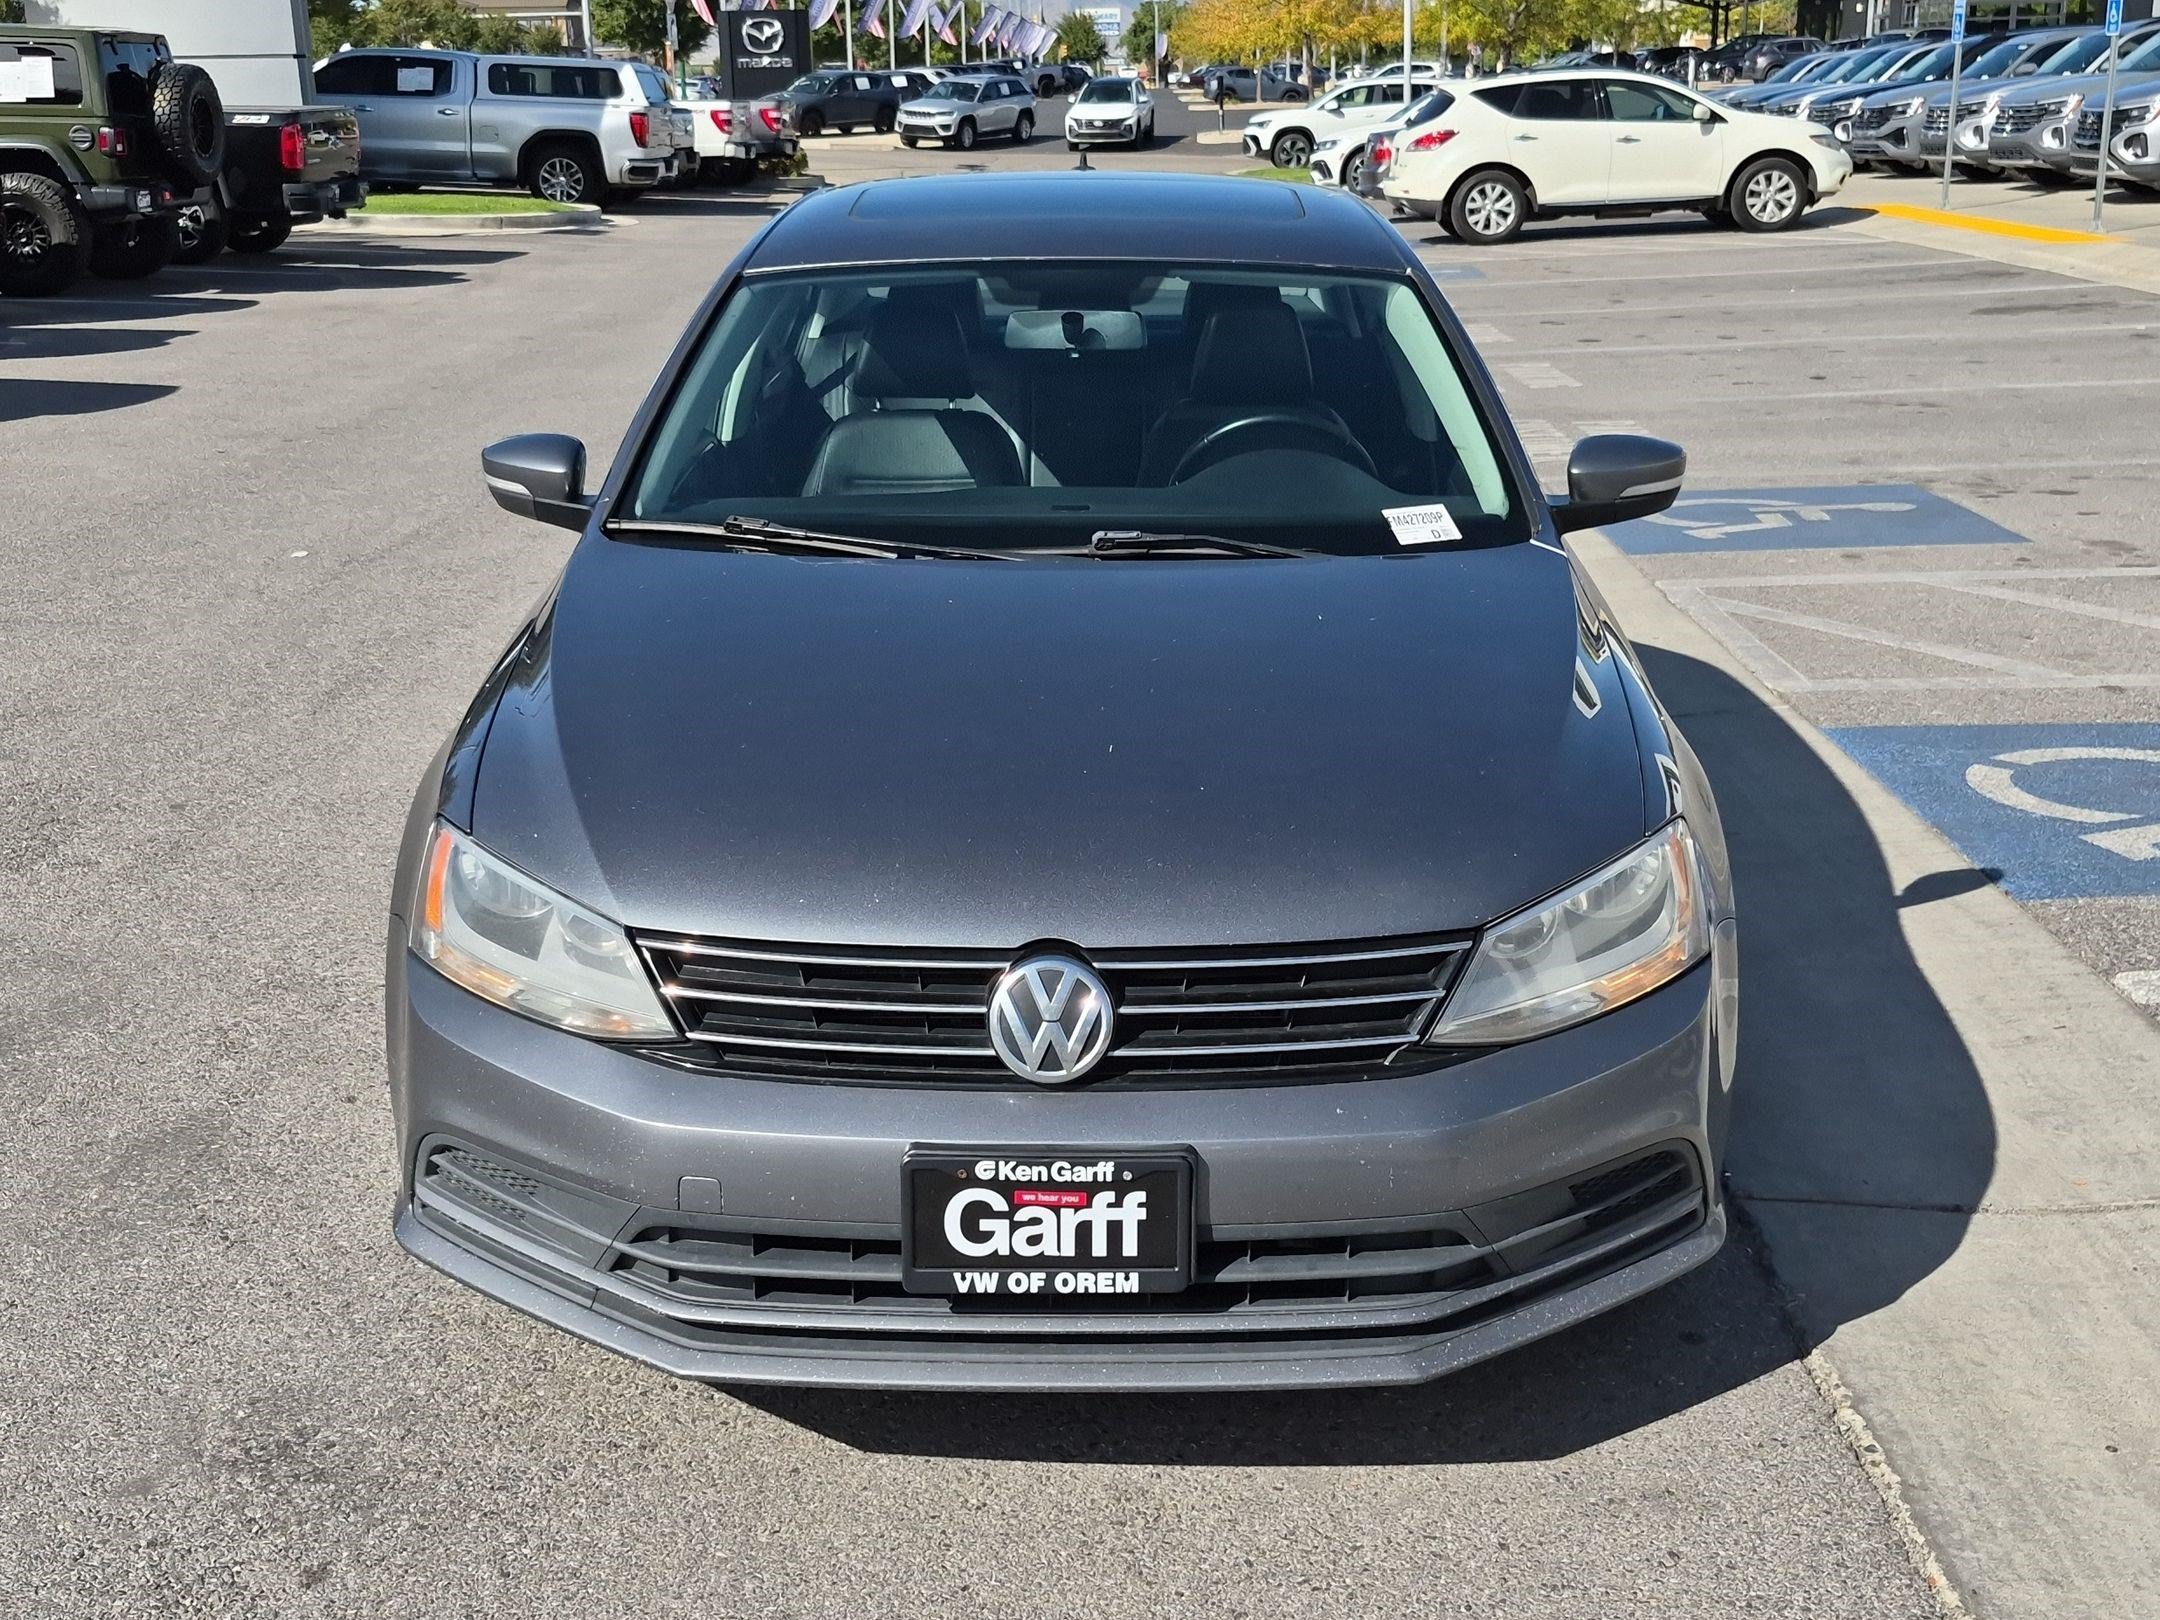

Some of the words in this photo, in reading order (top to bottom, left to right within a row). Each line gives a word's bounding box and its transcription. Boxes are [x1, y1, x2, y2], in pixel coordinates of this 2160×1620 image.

[737, 56, 794, 69] mazda
[998, 1160, 1049, 1182] Ken
[1050, 1160, 1115, 1183] Garff
[1021, 1193, 1037, 1202] we
[1037, 1191, 1060, 1203] hear
[1060, 1194, 1080, 1205] you
[943, 1187, 1147, 1258] Garff
[952, 1271, 1000, 1294] VW
[1006, 1271, 1047, 1294] OF
[1053, 1271, 1140, 1294] OREM
